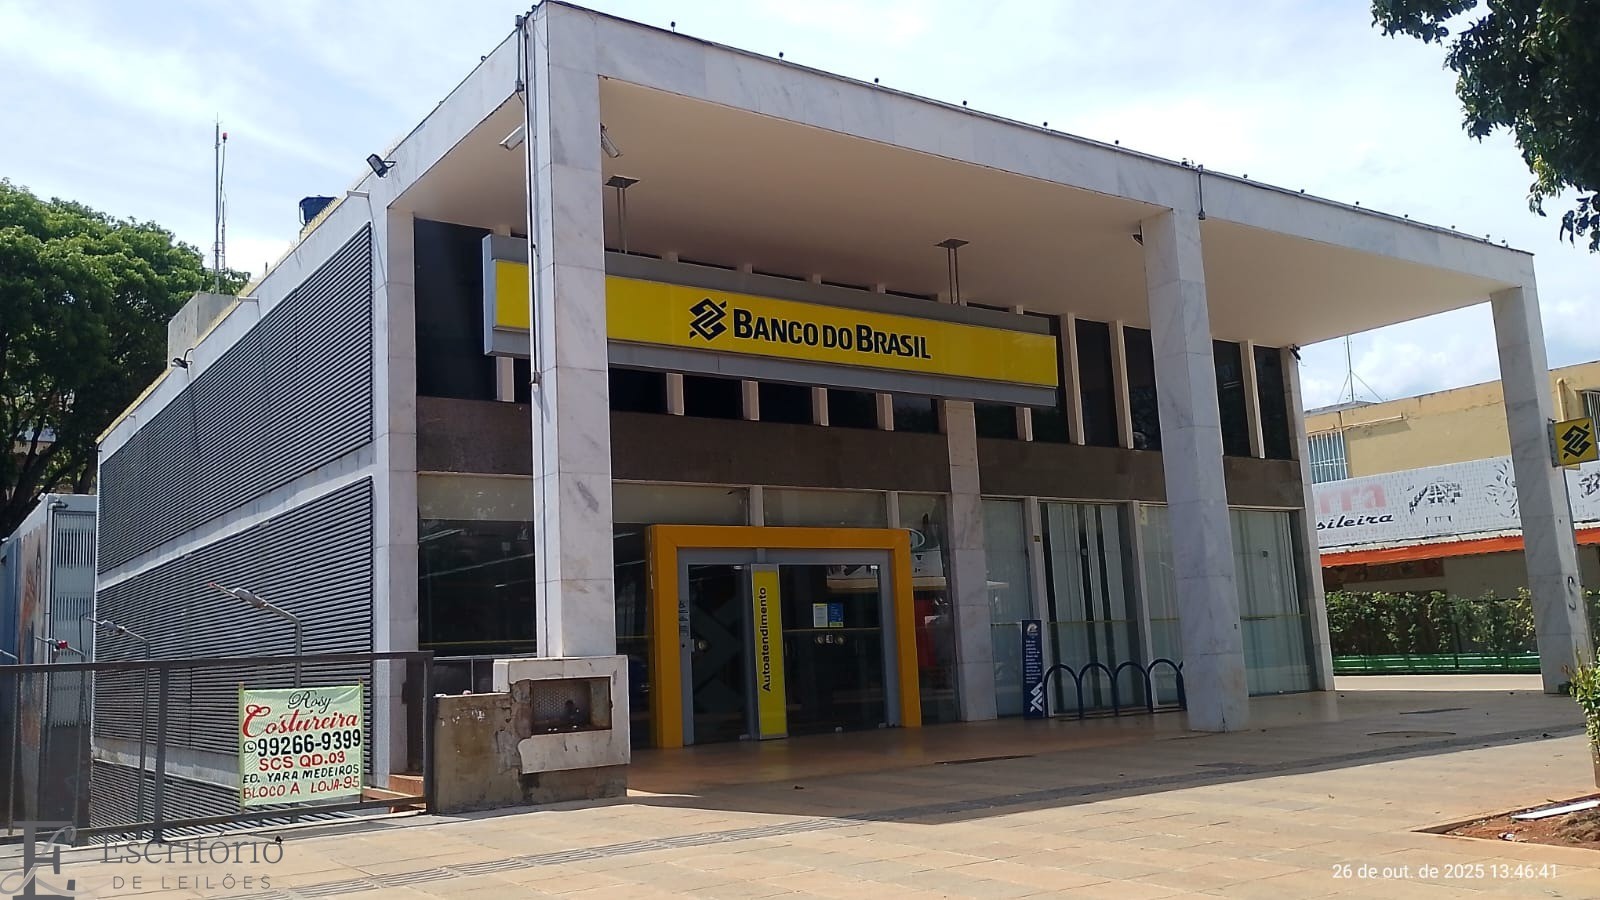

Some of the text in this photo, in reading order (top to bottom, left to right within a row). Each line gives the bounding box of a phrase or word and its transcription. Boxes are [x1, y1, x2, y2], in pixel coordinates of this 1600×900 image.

[733, 308, 932, 360] BANCO DO BRASIL
[759, 587, 771, 692] Autoatendimento
[287, 690, 332, 714] Rosy
[242, 704, 358, 738] Costureira
[257, 729, 361, 757] 99266-9399
[259, 750, 345, 771] SCS QD.03
[243, 764, 360, 784] ED. YARA MEDEIROS
[243, 776, 360, 799] BLOCO A LOJA-95
